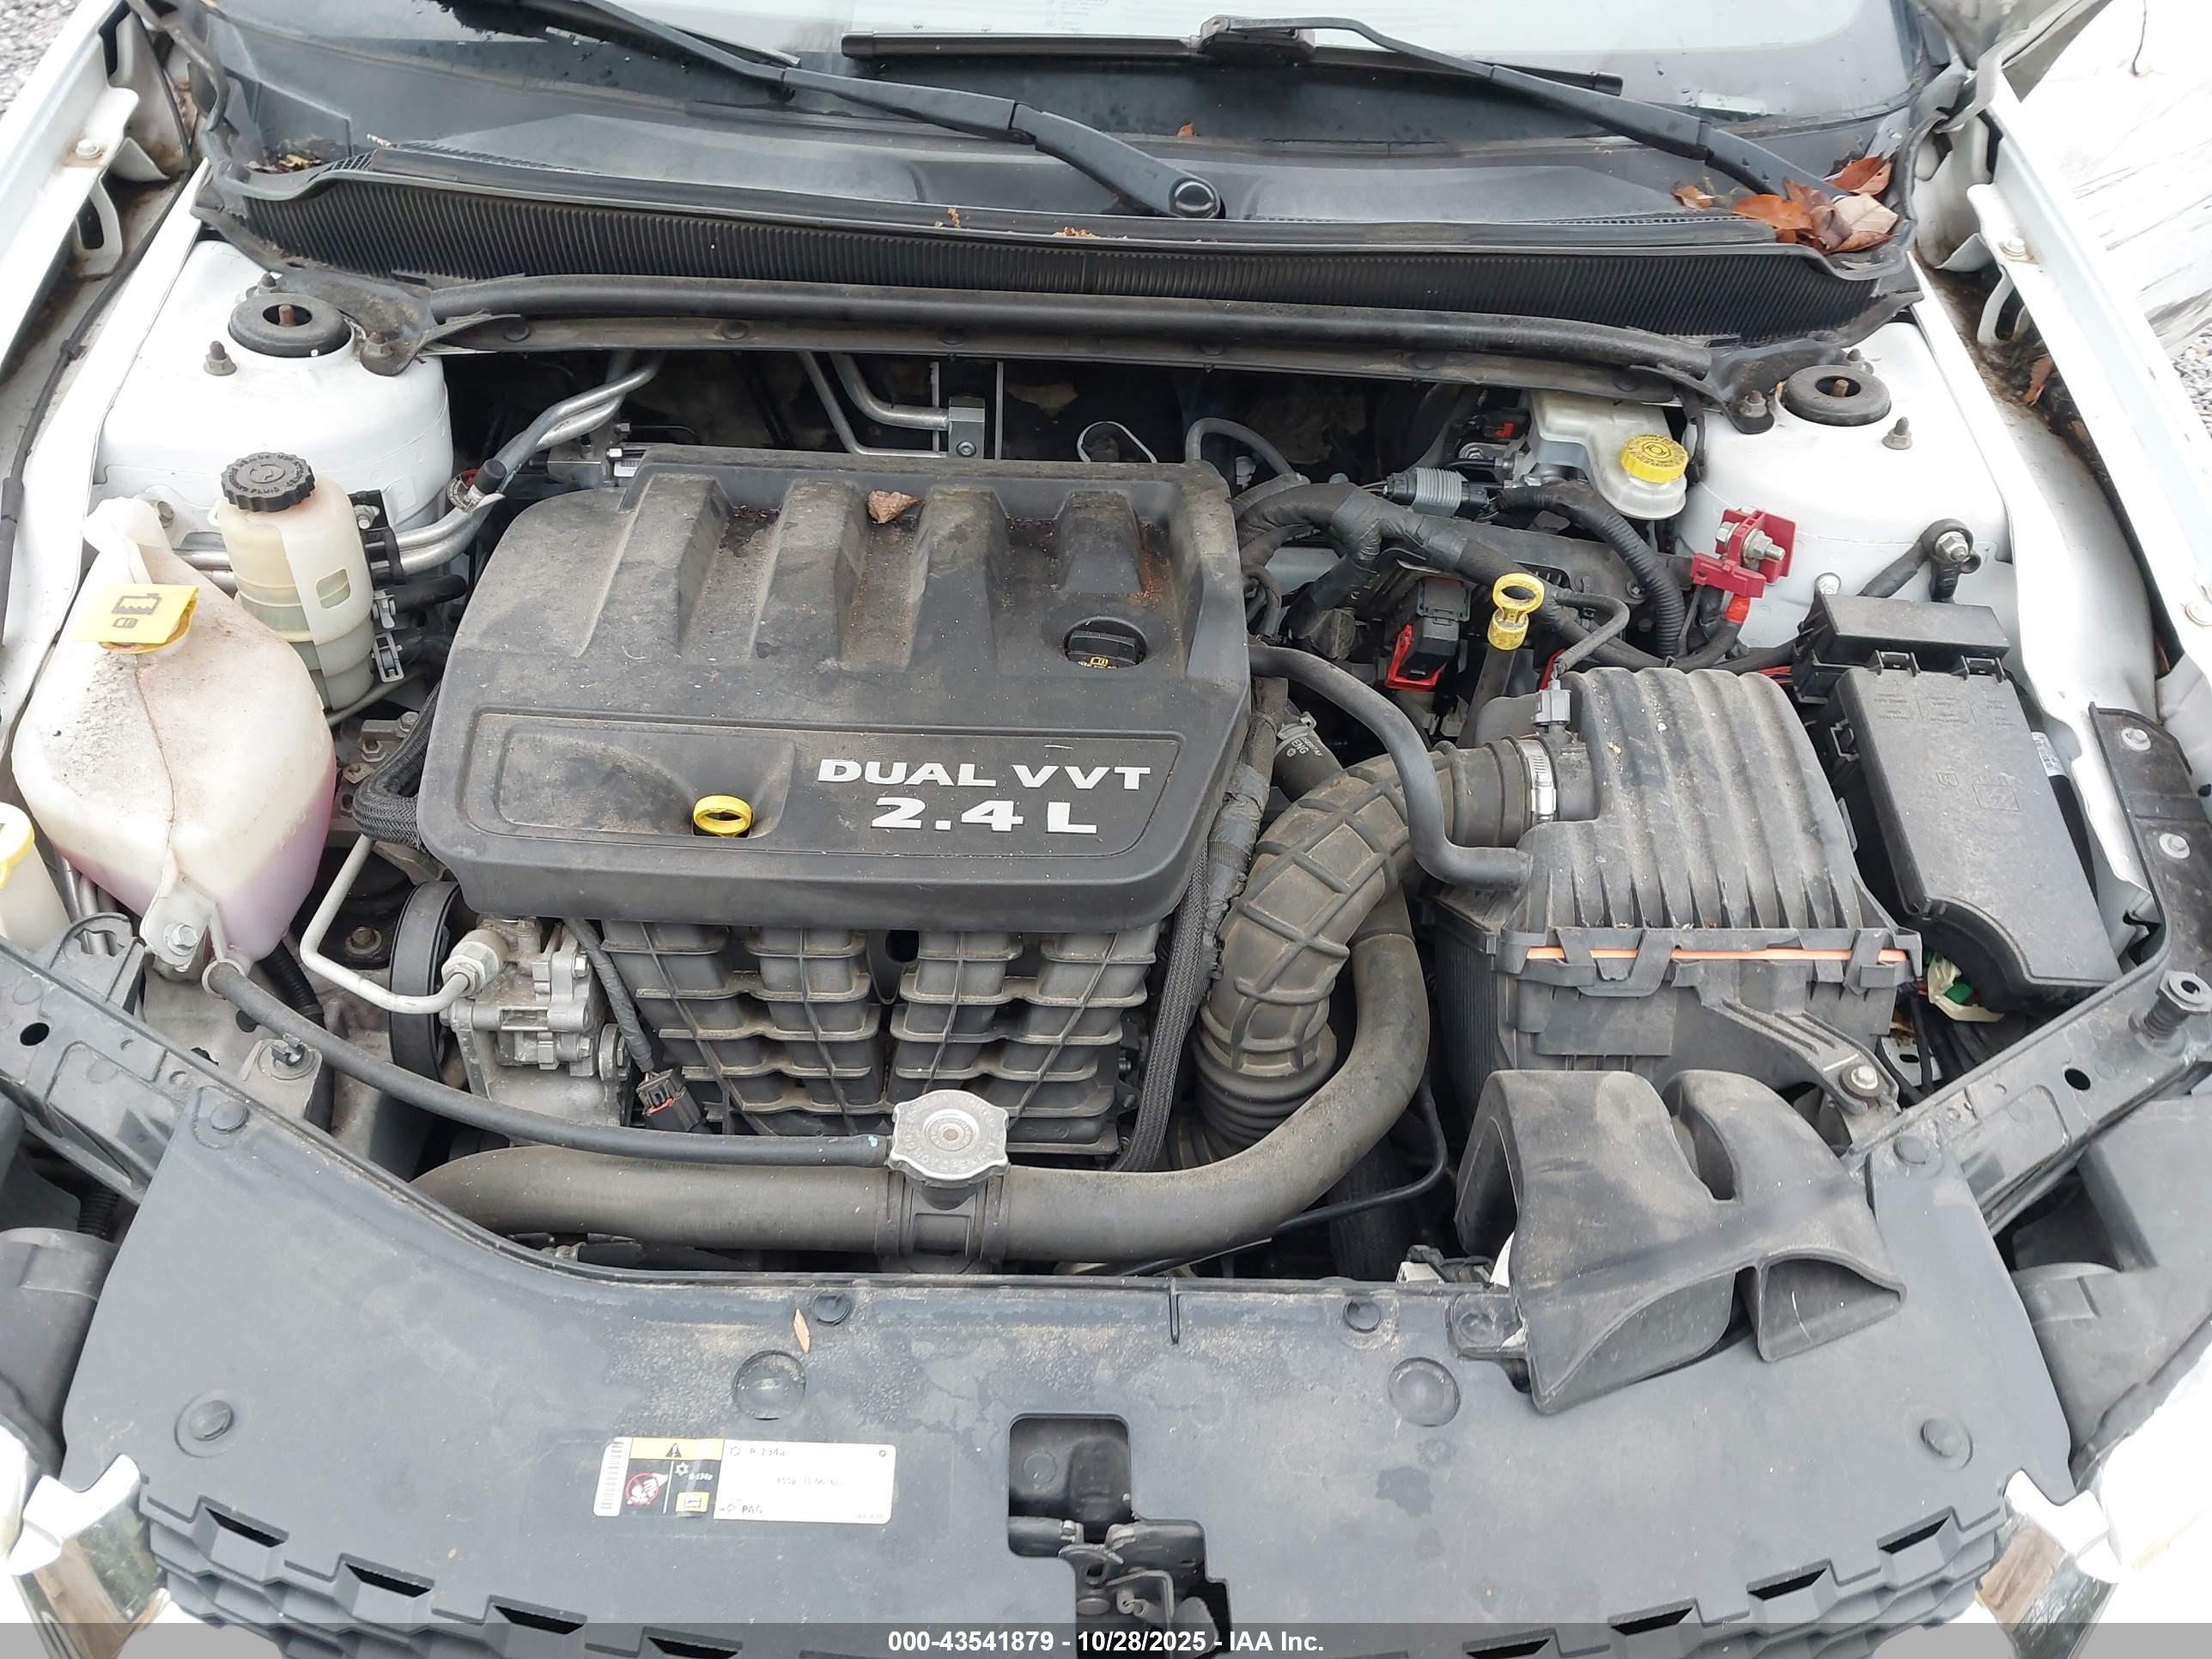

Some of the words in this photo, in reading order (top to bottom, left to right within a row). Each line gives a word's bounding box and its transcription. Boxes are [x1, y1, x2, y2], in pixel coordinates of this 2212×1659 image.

[1291, 738, 1310, 755] ENG
[817, 759, 996, 787] DUAL
[1012, 764, 1151, 791] VVT
[871, 797, 1024, 832] 2.4
[1047, 801, 1097, 834] L
